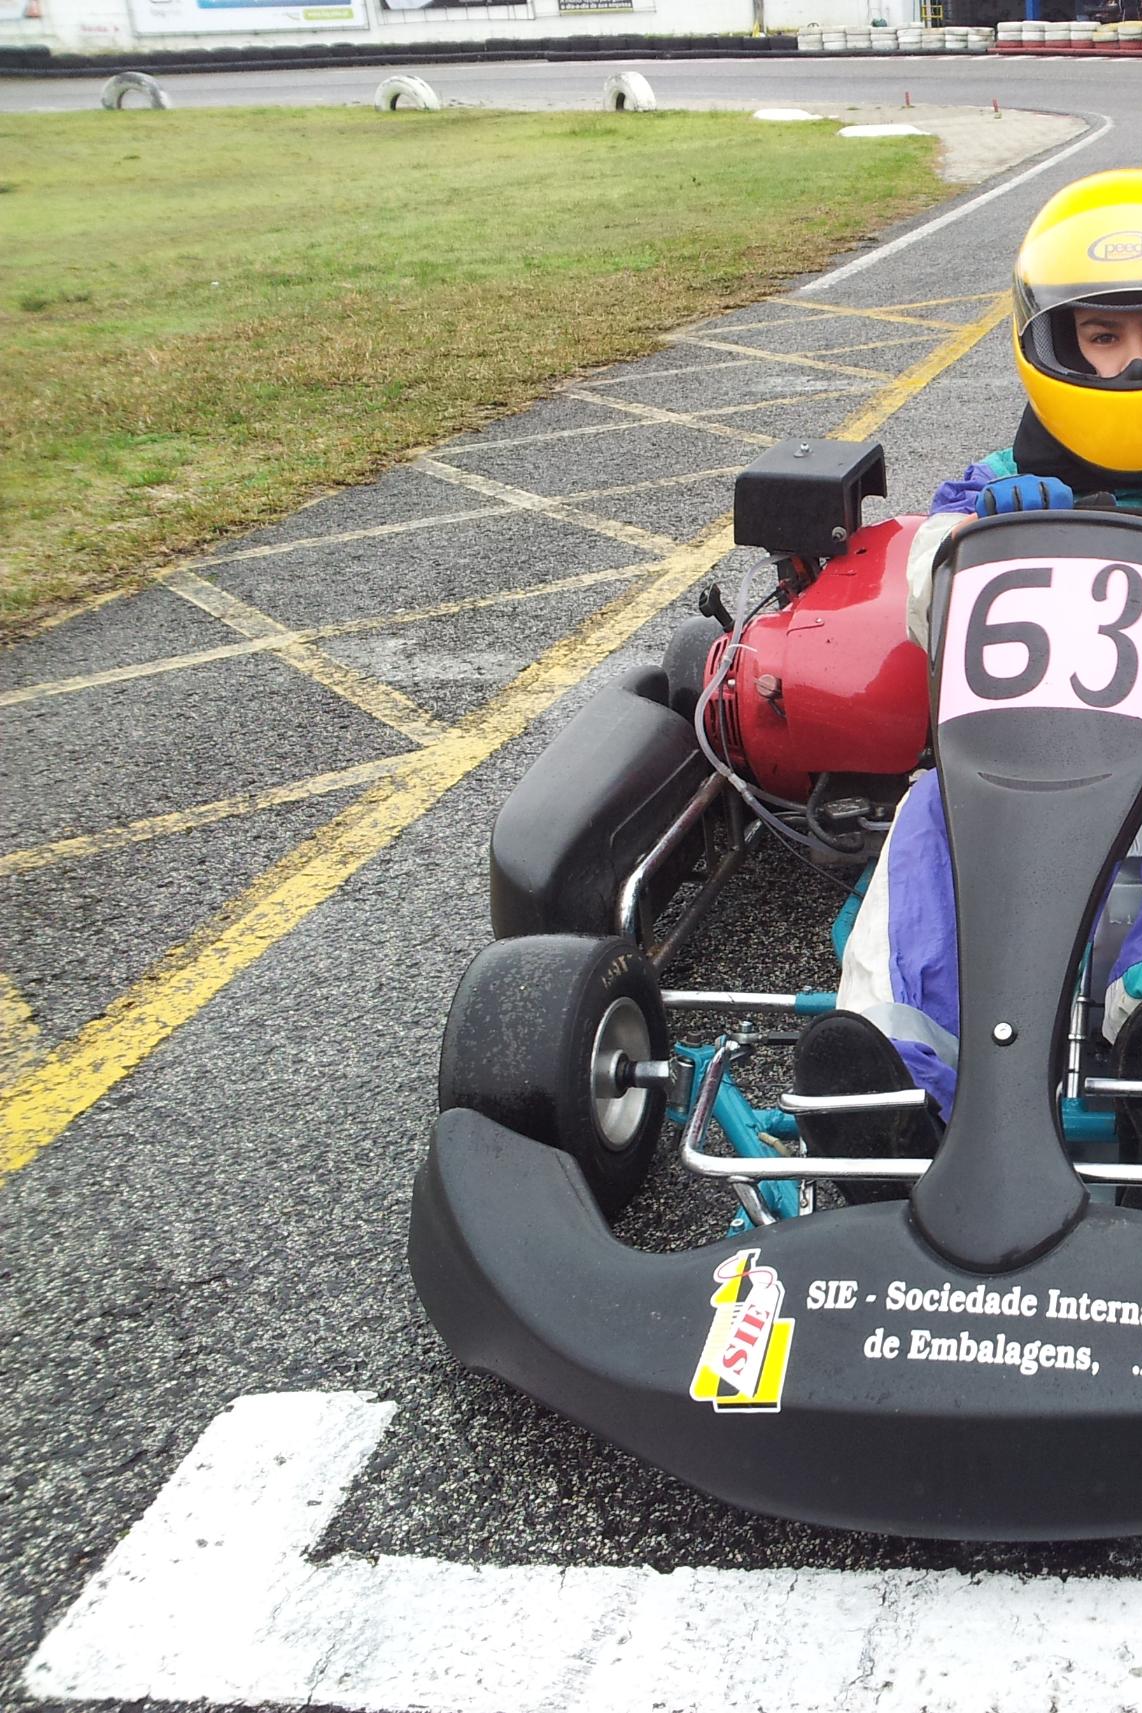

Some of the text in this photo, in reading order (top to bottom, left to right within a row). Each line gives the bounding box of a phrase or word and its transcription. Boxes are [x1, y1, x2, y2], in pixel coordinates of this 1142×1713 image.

[806, 1280, 858, 1310] SIE
[885, 1281, 1038, 1317] Sociedade
[722, 1304, 770, 1376] SIE
[863, 1328, 901, 1359] de
[907, 1329, 1100, 1376] Embalagens,
